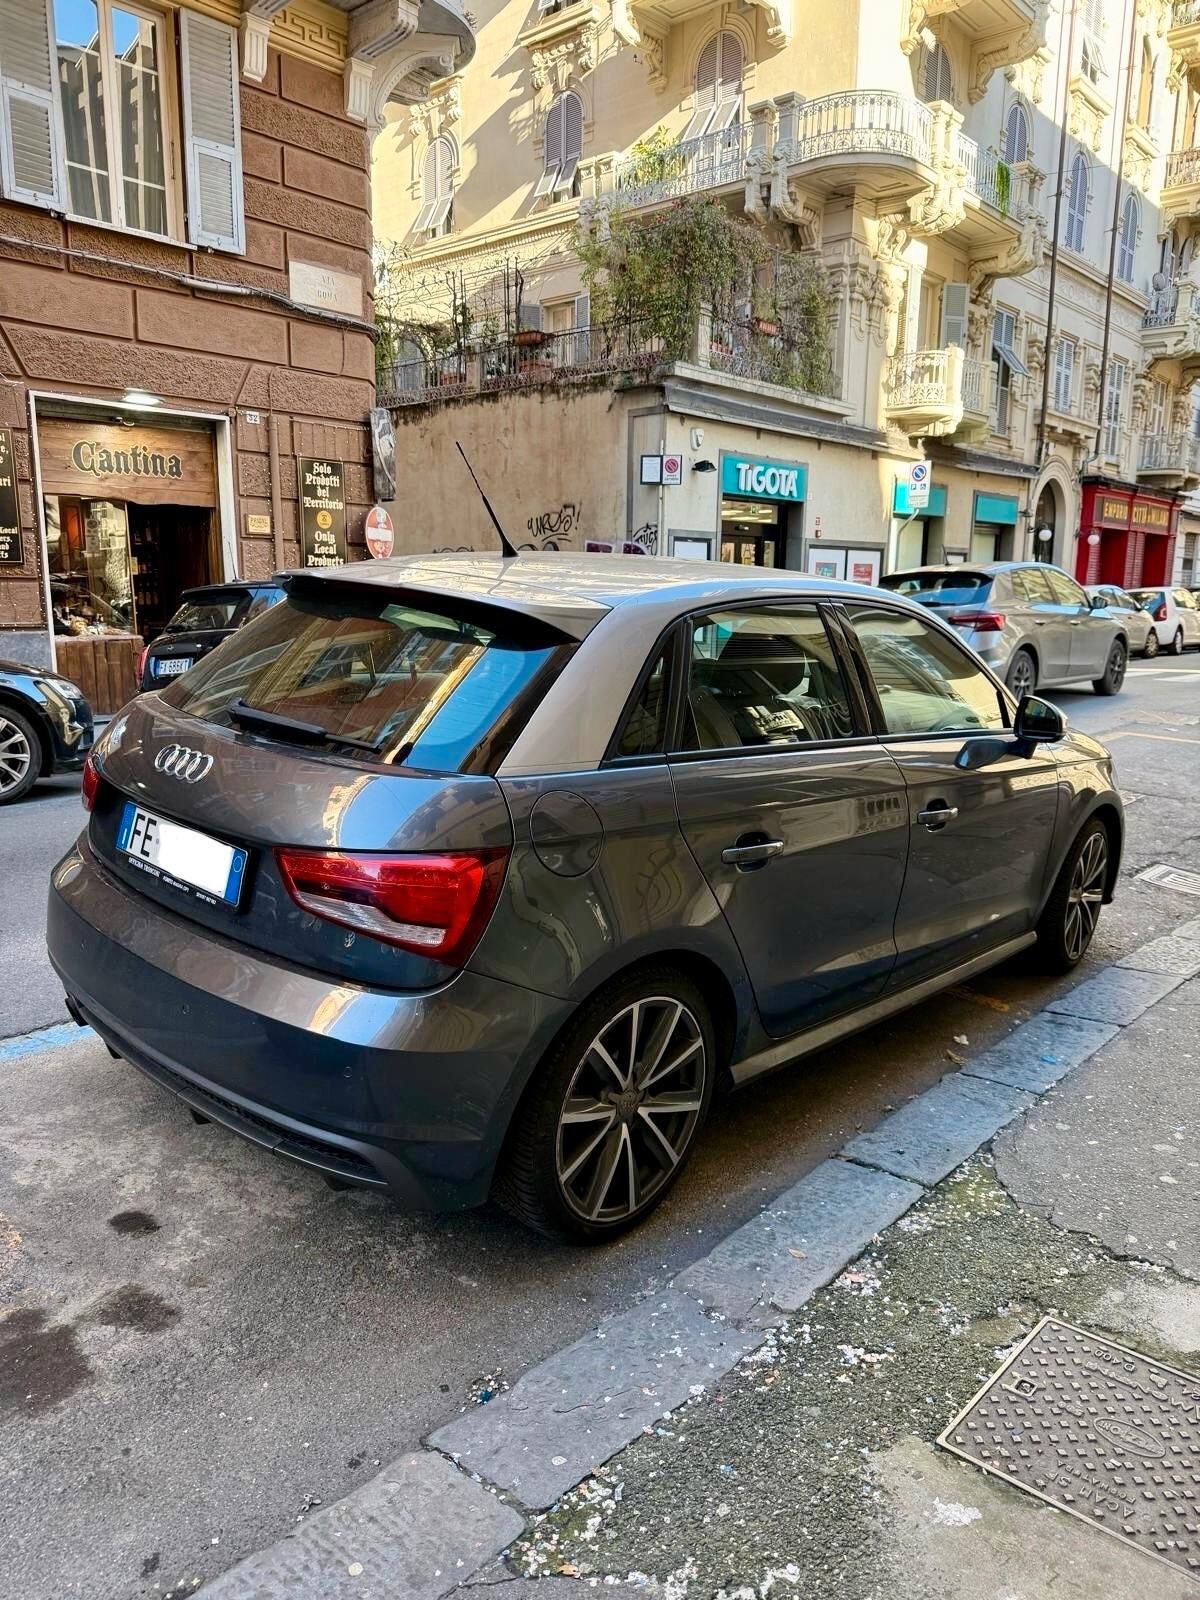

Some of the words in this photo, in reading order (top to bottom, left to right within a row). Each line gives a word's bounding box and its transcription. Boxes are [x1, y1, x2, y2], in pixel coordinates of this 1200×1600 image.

[71, 440, 184, 481] Cantina
[313, 462, 332, 475] Solo
[305, 473, 340, 488] Prodotti
[316, 486, 330, 498] del
[303, 496, 344, 511] Territorio
[314, 531, 336, 545] Only
[314, 544, 337, 555] Local
[307, 554, 344, 568] Products
[130, 813, 157, 857] FE
